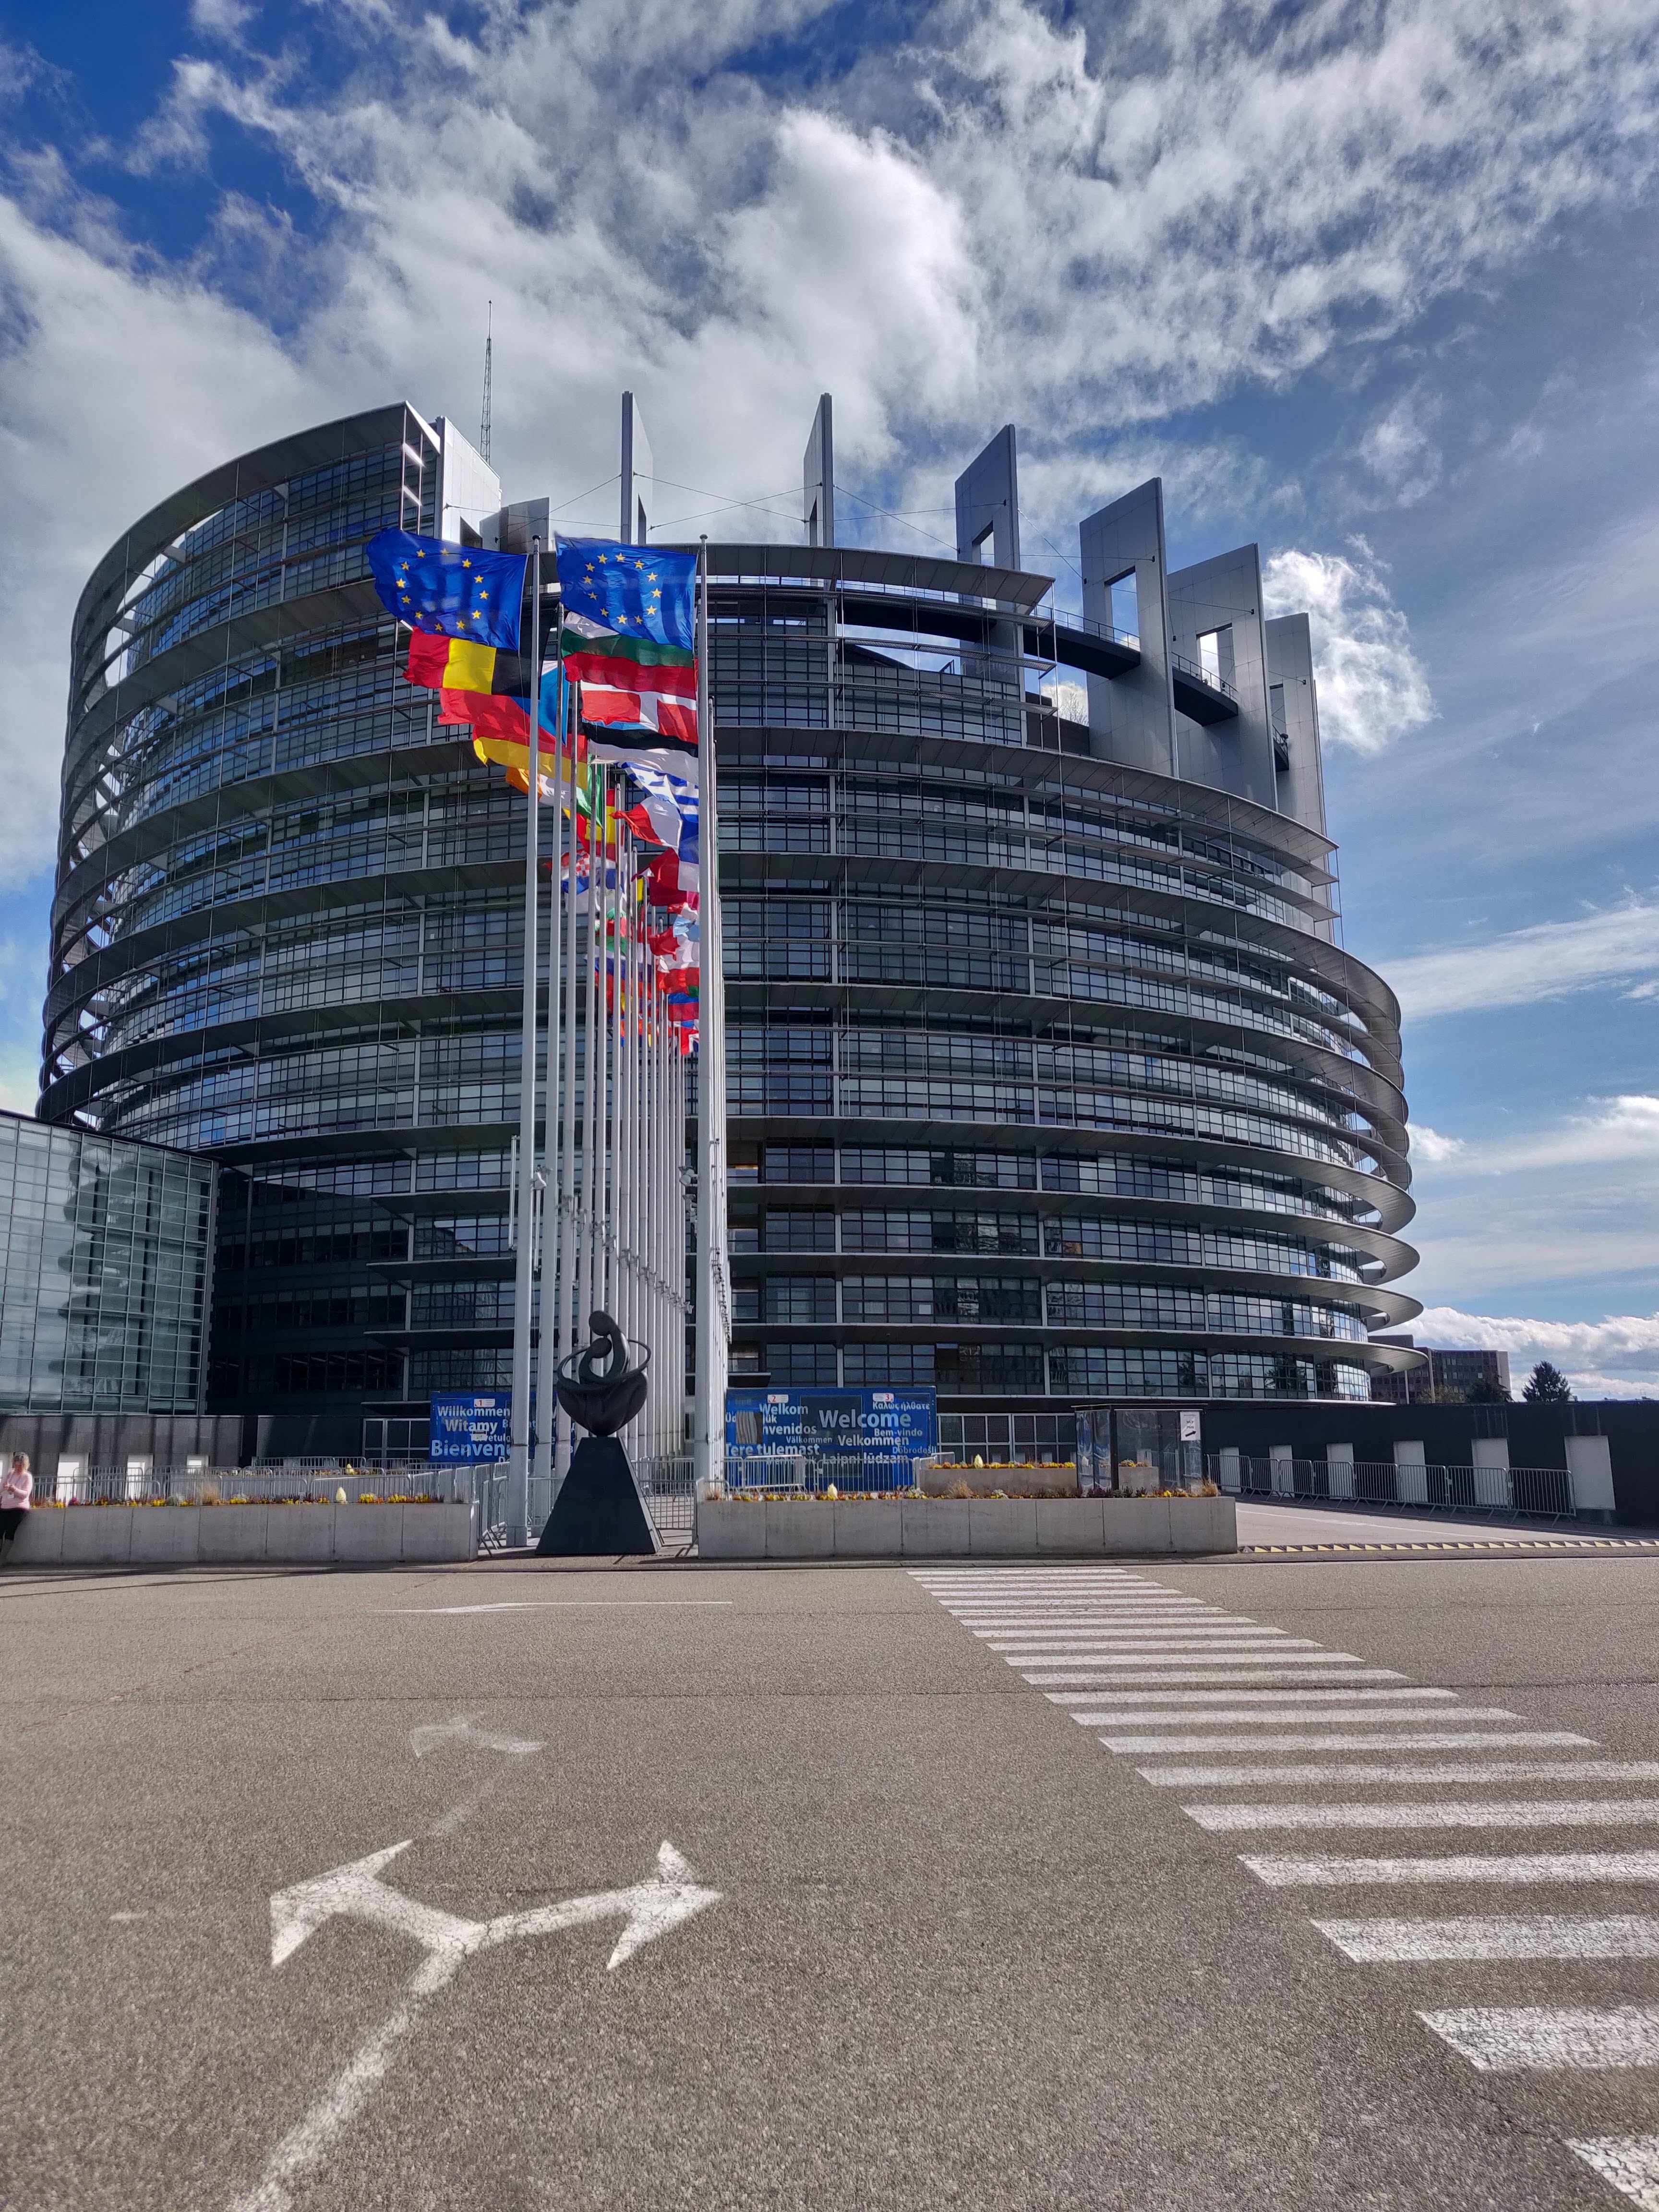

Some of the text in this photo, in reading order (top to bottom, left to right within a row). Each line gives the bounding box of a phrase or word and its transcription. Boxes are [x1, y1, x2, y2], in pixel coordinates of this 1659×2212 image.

[437, 1406, 510, 1417] Willkommen
[759, 1403, 808, 1415] Welkom
[819, 1408, 911, 1428] Welcome
[445, 1419, 498, 1434] Witamy
[874, 1428, 923, 1437] Bem-vindo
[786, 1435, 832, 1443] Välkommen
[838, 1434, 909, 1446] Velkommen
[726, 1442, 820, 1456] Tere tulemast
